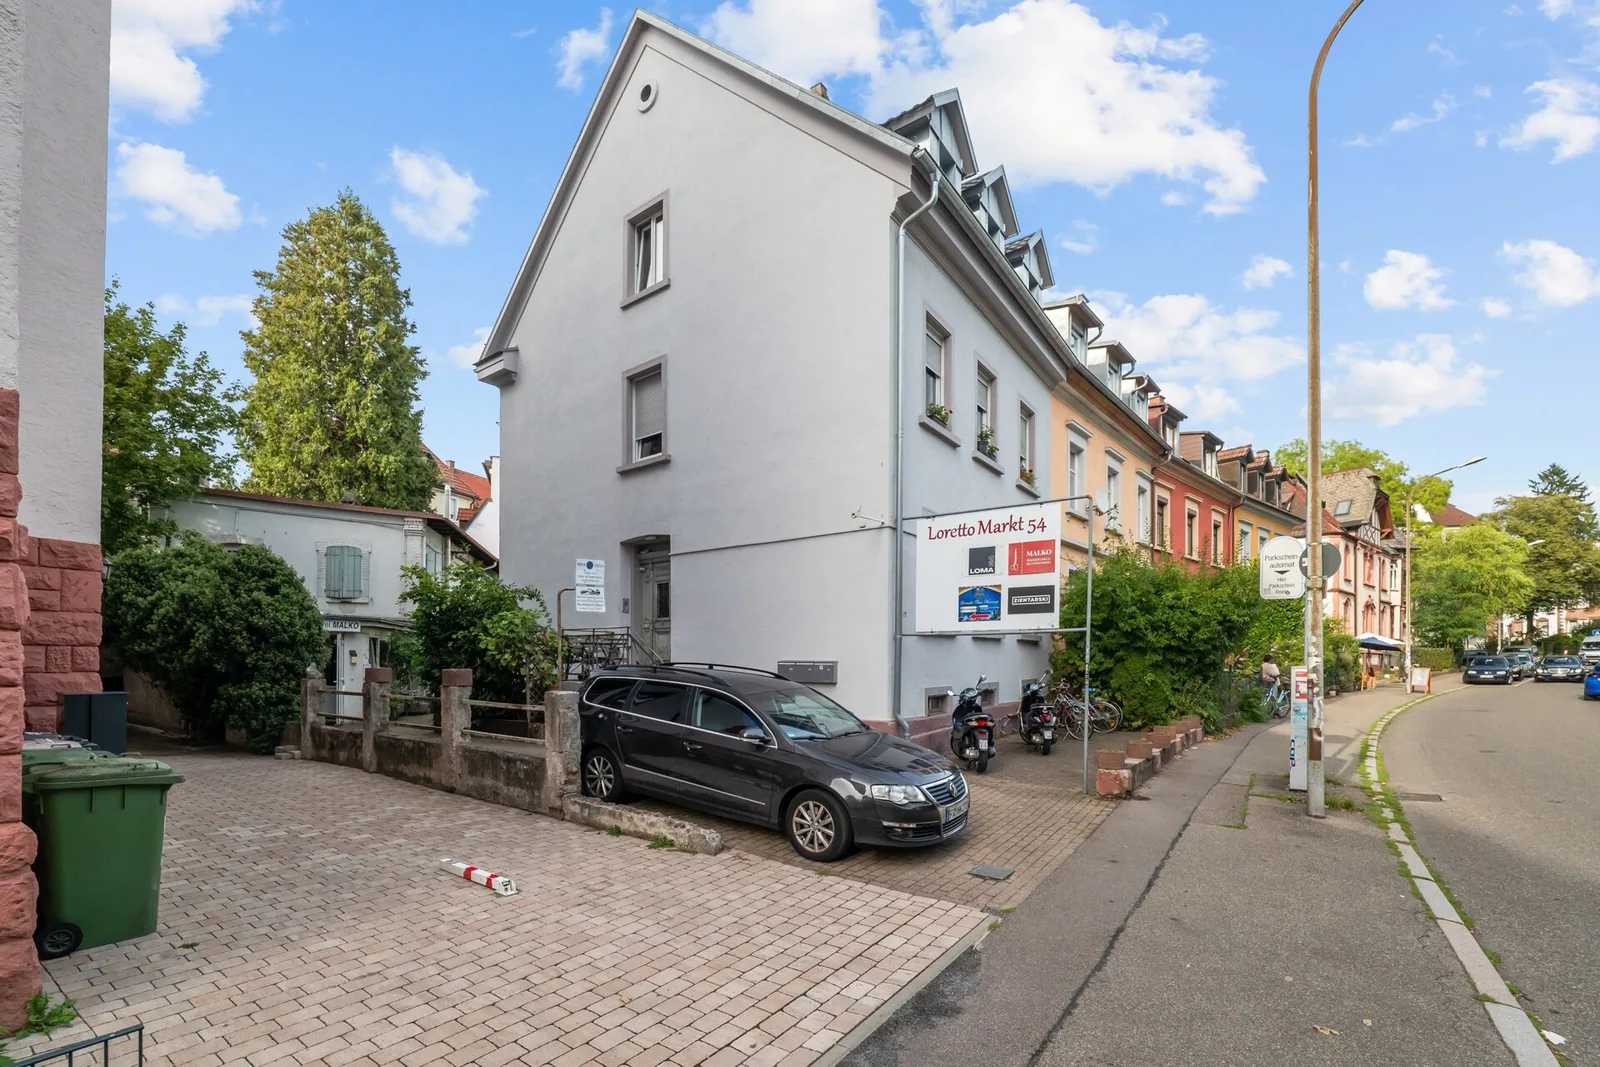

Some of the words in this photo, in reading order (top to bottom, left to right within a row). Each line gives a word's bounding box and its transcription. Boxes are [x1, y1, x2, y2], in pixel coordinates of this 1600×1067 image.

[927, 522, 975, 541] Loretto
[977, 514, 1024, 536] Markt
[1027, 517, 1047, 534] 54
[1026, 549, 1052, 557] MALKO
[1264, 554, 1300, 562] Parkschein-
[1269, 561, 1295, 569] automat
[969, 567, 994, 575] LOMA
[1013, 596, 1049, 604] ZIENTARSKI
[332, 621, 359, 630] MALKO
